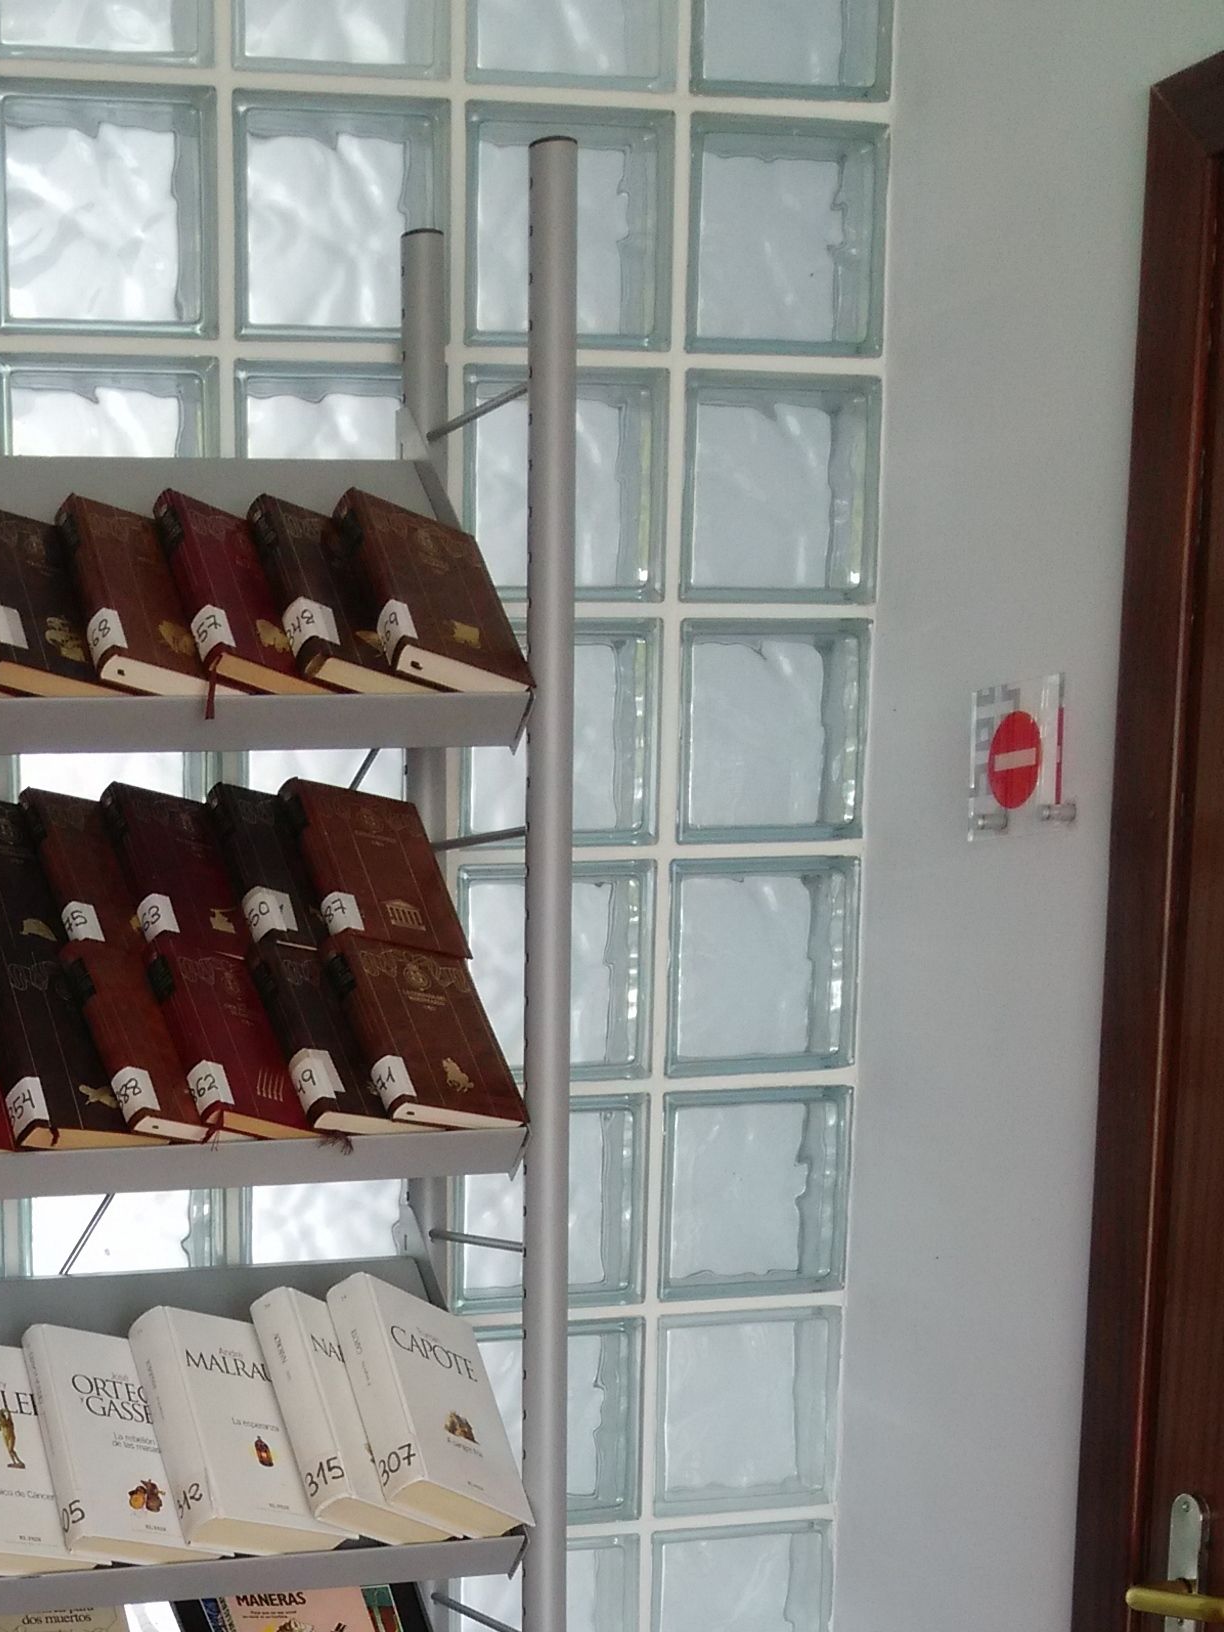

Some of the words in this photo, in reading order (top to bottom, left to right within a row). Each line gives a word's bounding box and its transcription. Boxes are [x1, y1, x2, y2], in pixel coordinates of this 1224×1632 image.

[390, 1325, 479, 1383] CAPOTE
[306, 1456, 345, 1498] 315
[379, 1443, 417, 1487] 307
[22, 1614, 43, 1625] dos
[45, 1612, 92, 1625] muertos
[235, 1591, 307, 1607] MANERAS
